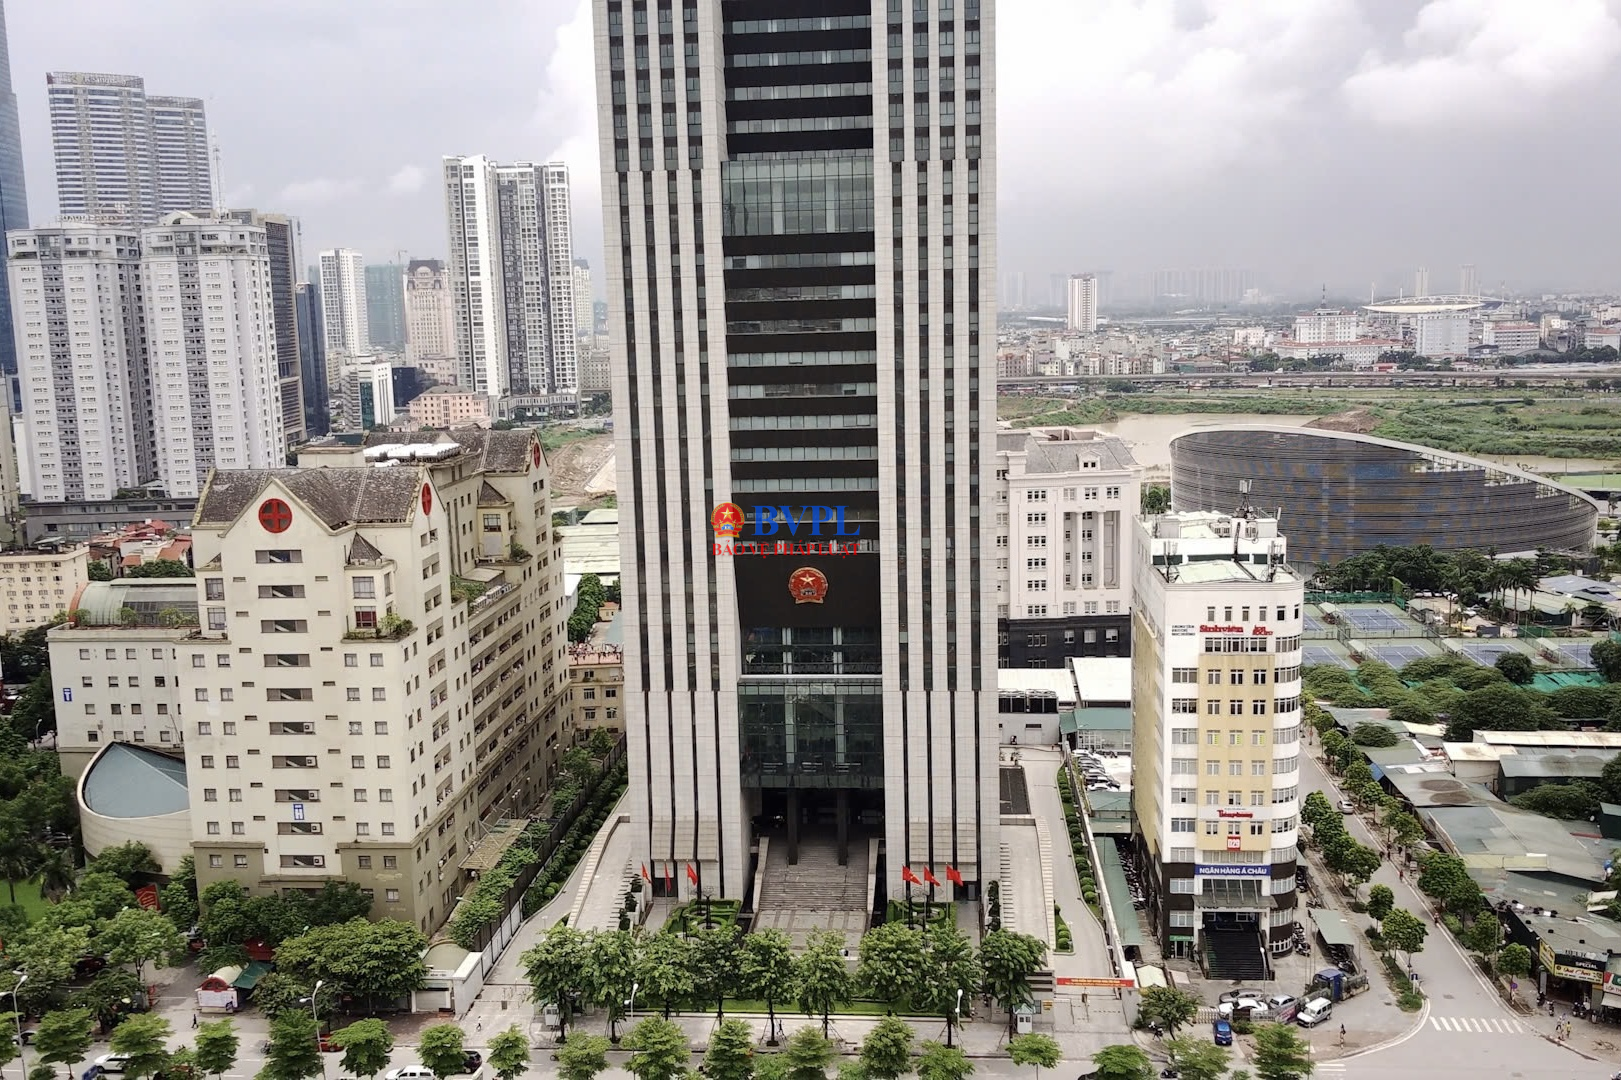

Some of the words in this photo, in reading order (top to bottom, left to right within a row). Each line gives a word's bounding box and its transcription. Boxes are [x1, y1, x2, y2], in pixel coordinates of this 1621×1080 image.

[1199, 866, 1219, 874] NGÂN
[1220, 866, 1240, 875] HÀNG
[1247, 867, 1267, 875] CHÂU
